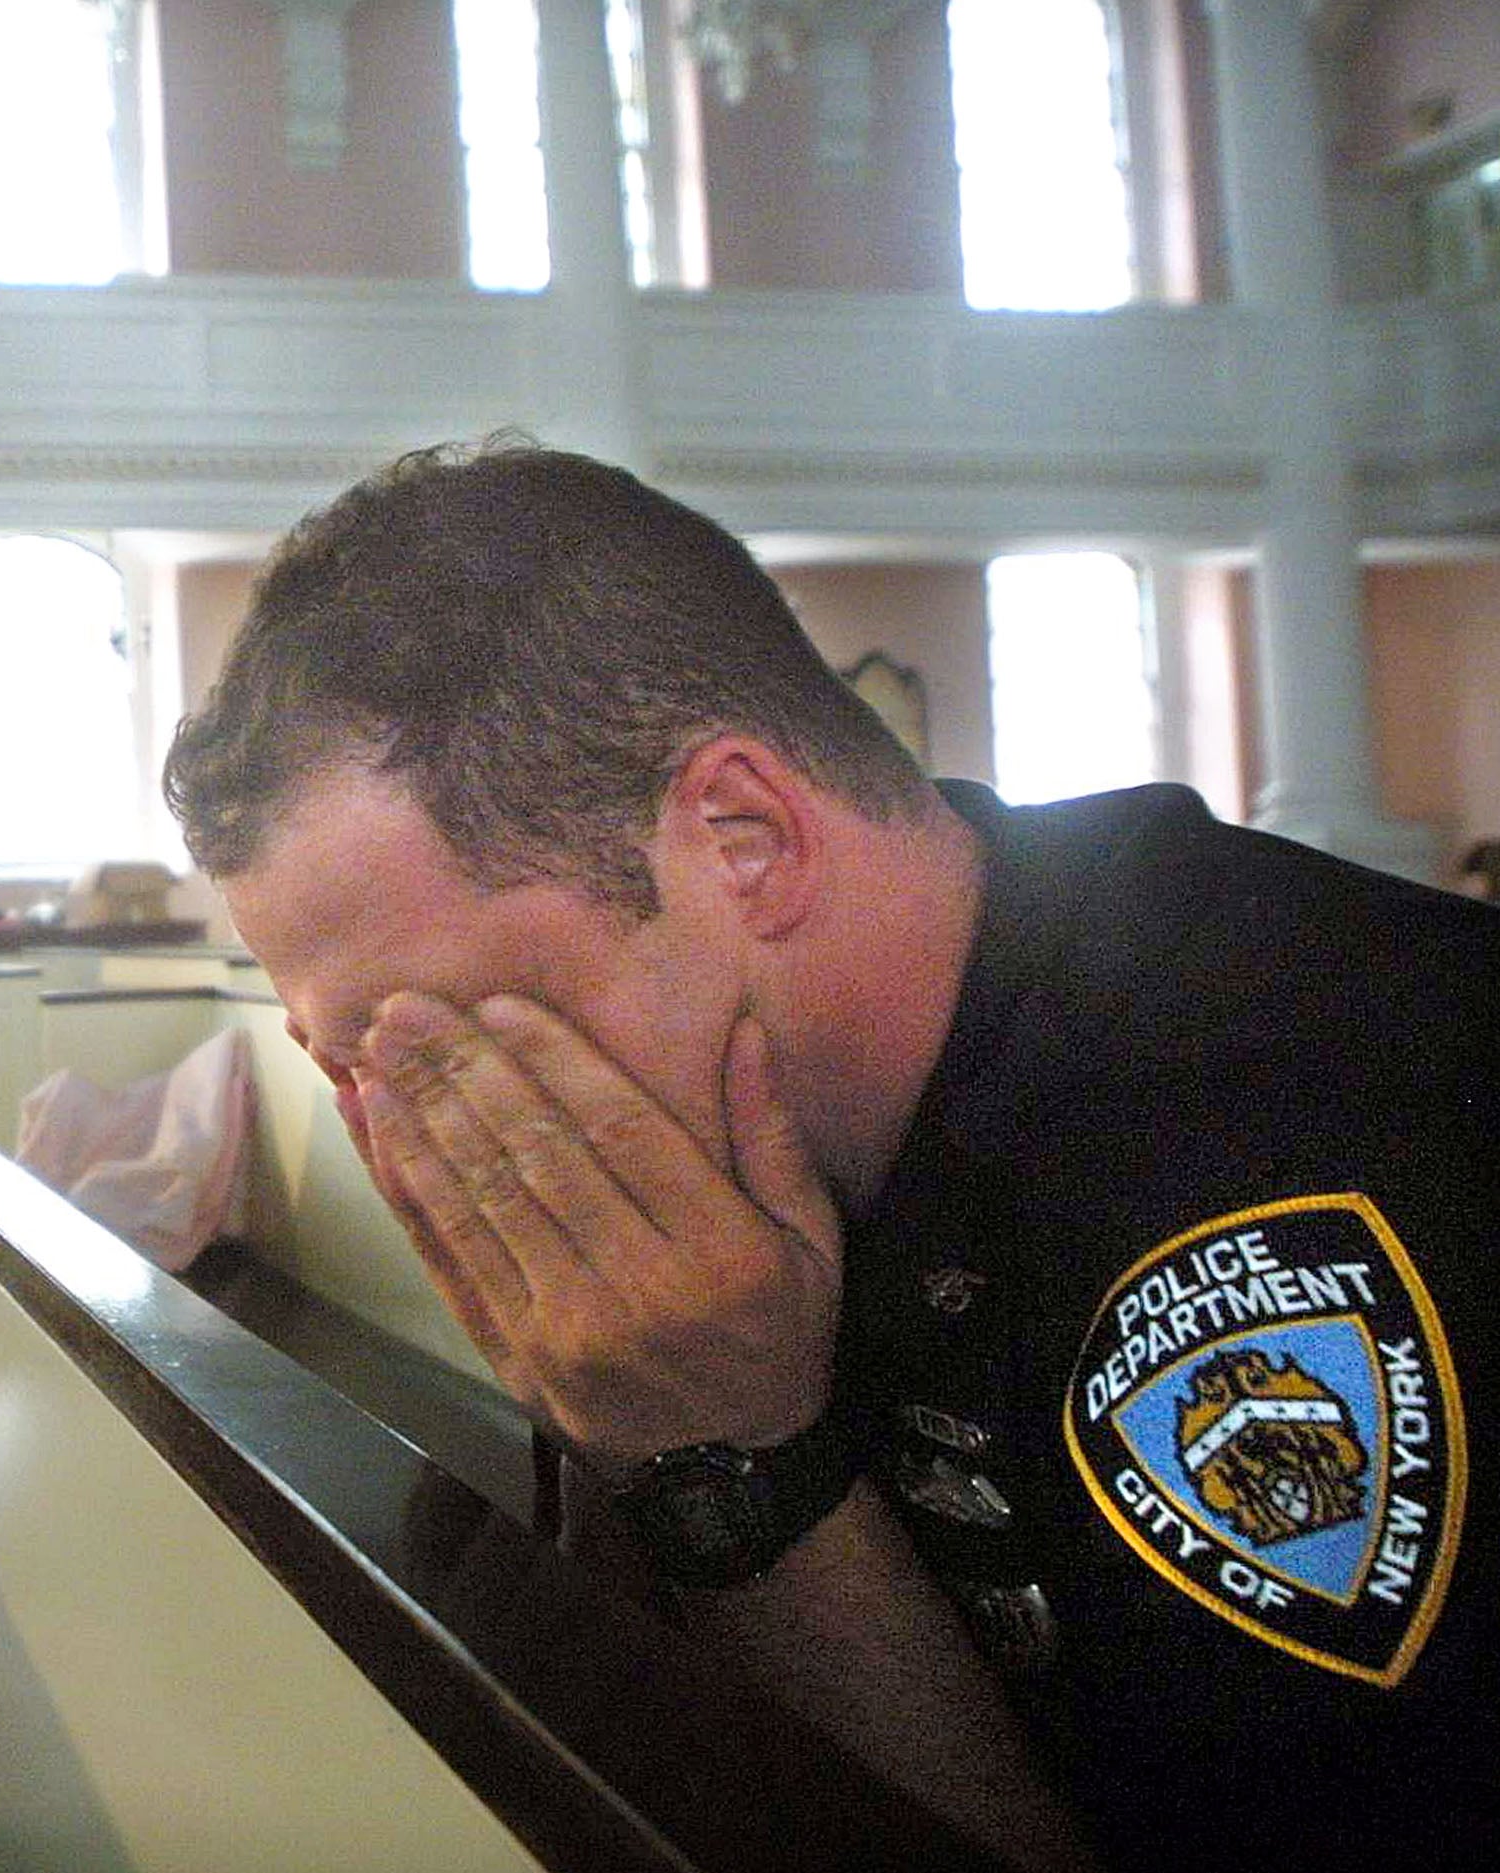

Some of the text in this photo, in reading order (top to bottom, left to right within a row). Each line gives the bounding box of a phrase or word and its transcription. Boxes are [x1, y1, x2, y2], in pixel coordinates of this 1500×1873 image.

[1085, 1263, 1376, 1421] DEPARTMENT
[1116, 1231, 1279, 1336] POLICE
[1115, 1468, 1295, 1610] CITY OF
[1368, 1337, 1431, 1603] NEW YORK
